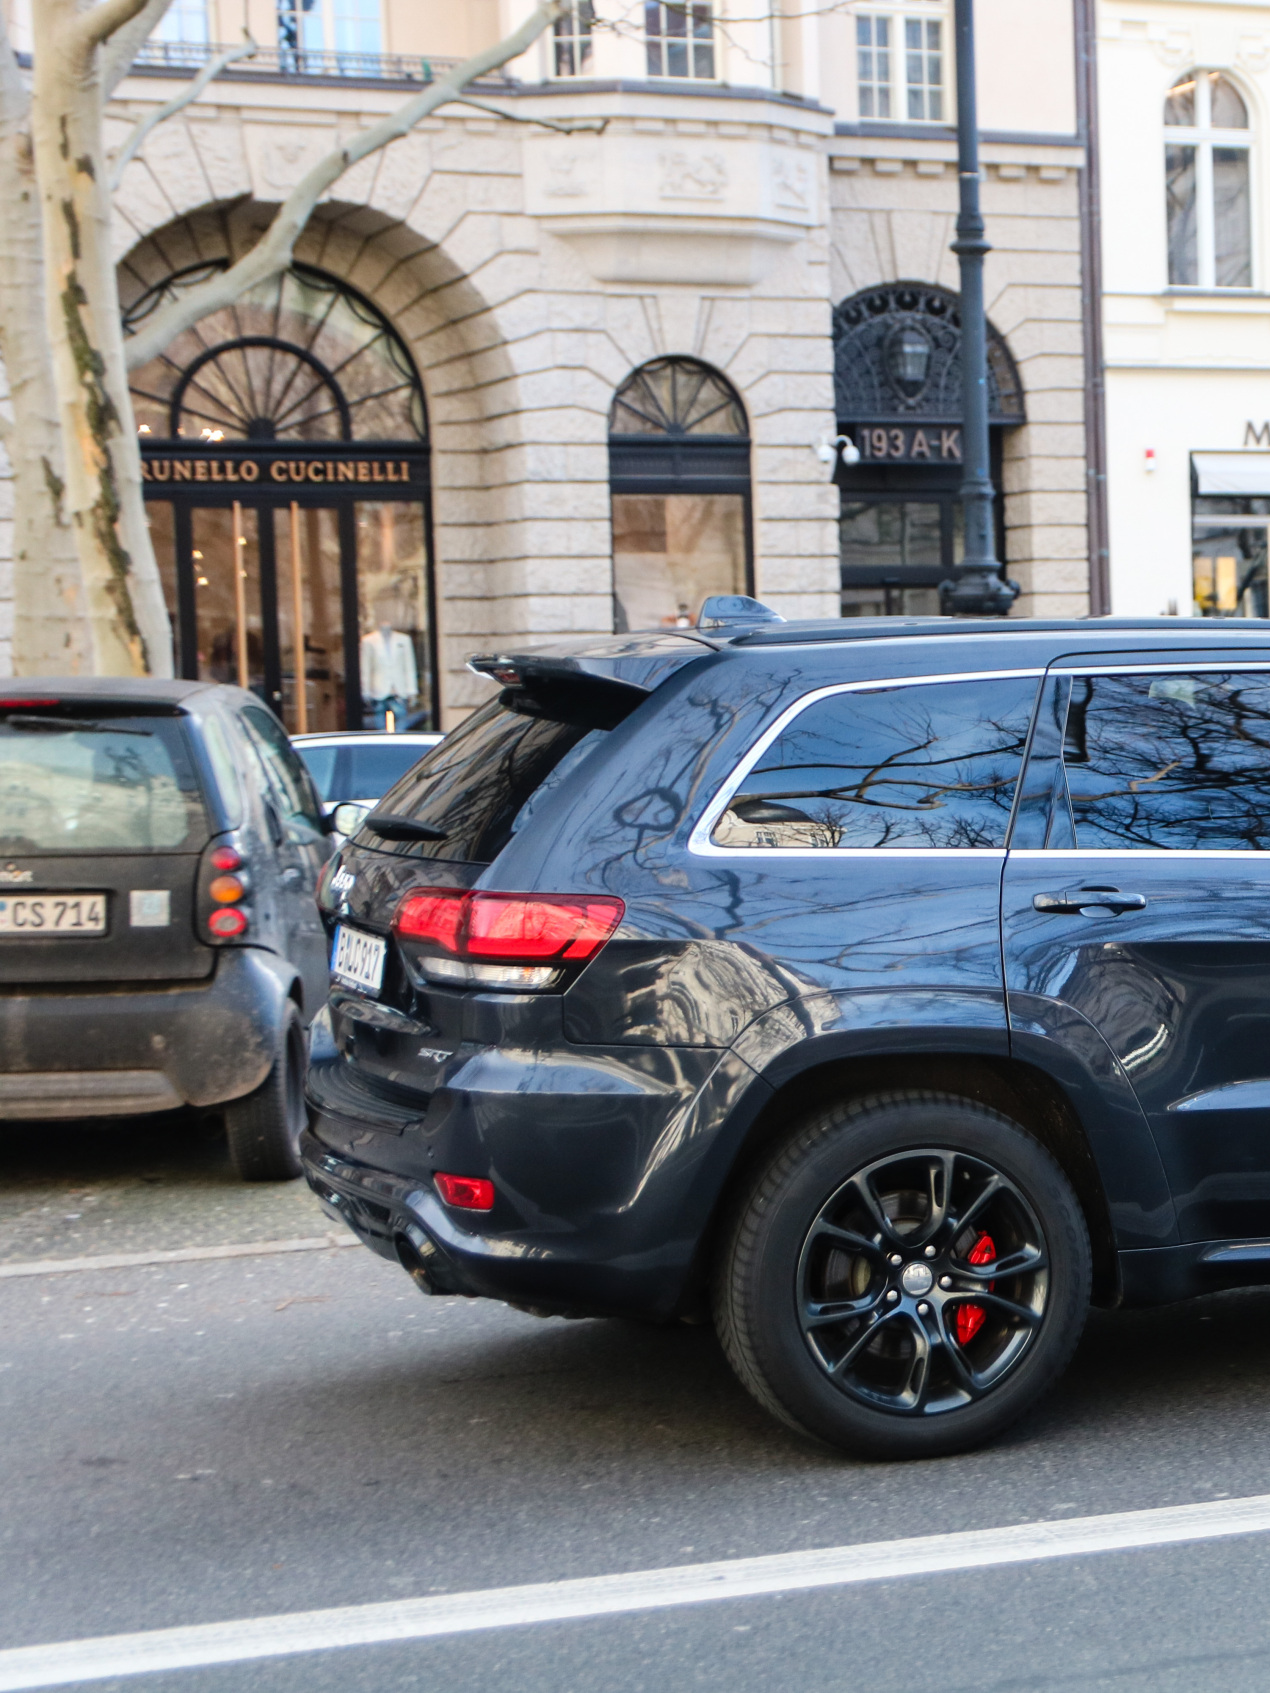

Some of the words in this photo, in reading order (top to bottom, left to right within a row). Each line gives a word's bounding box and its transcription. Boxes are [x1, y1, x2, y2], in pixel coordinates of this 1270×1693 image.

[861, 428, 905, 457] 193
[910, 429, 962, 460] A-K
[141, 459, 260, 482] RUNELLO
[269, 460, 410, 482] CUCINELLI
[12, 902, 45, 928] CS
[53, 901, 101, 927] 714
